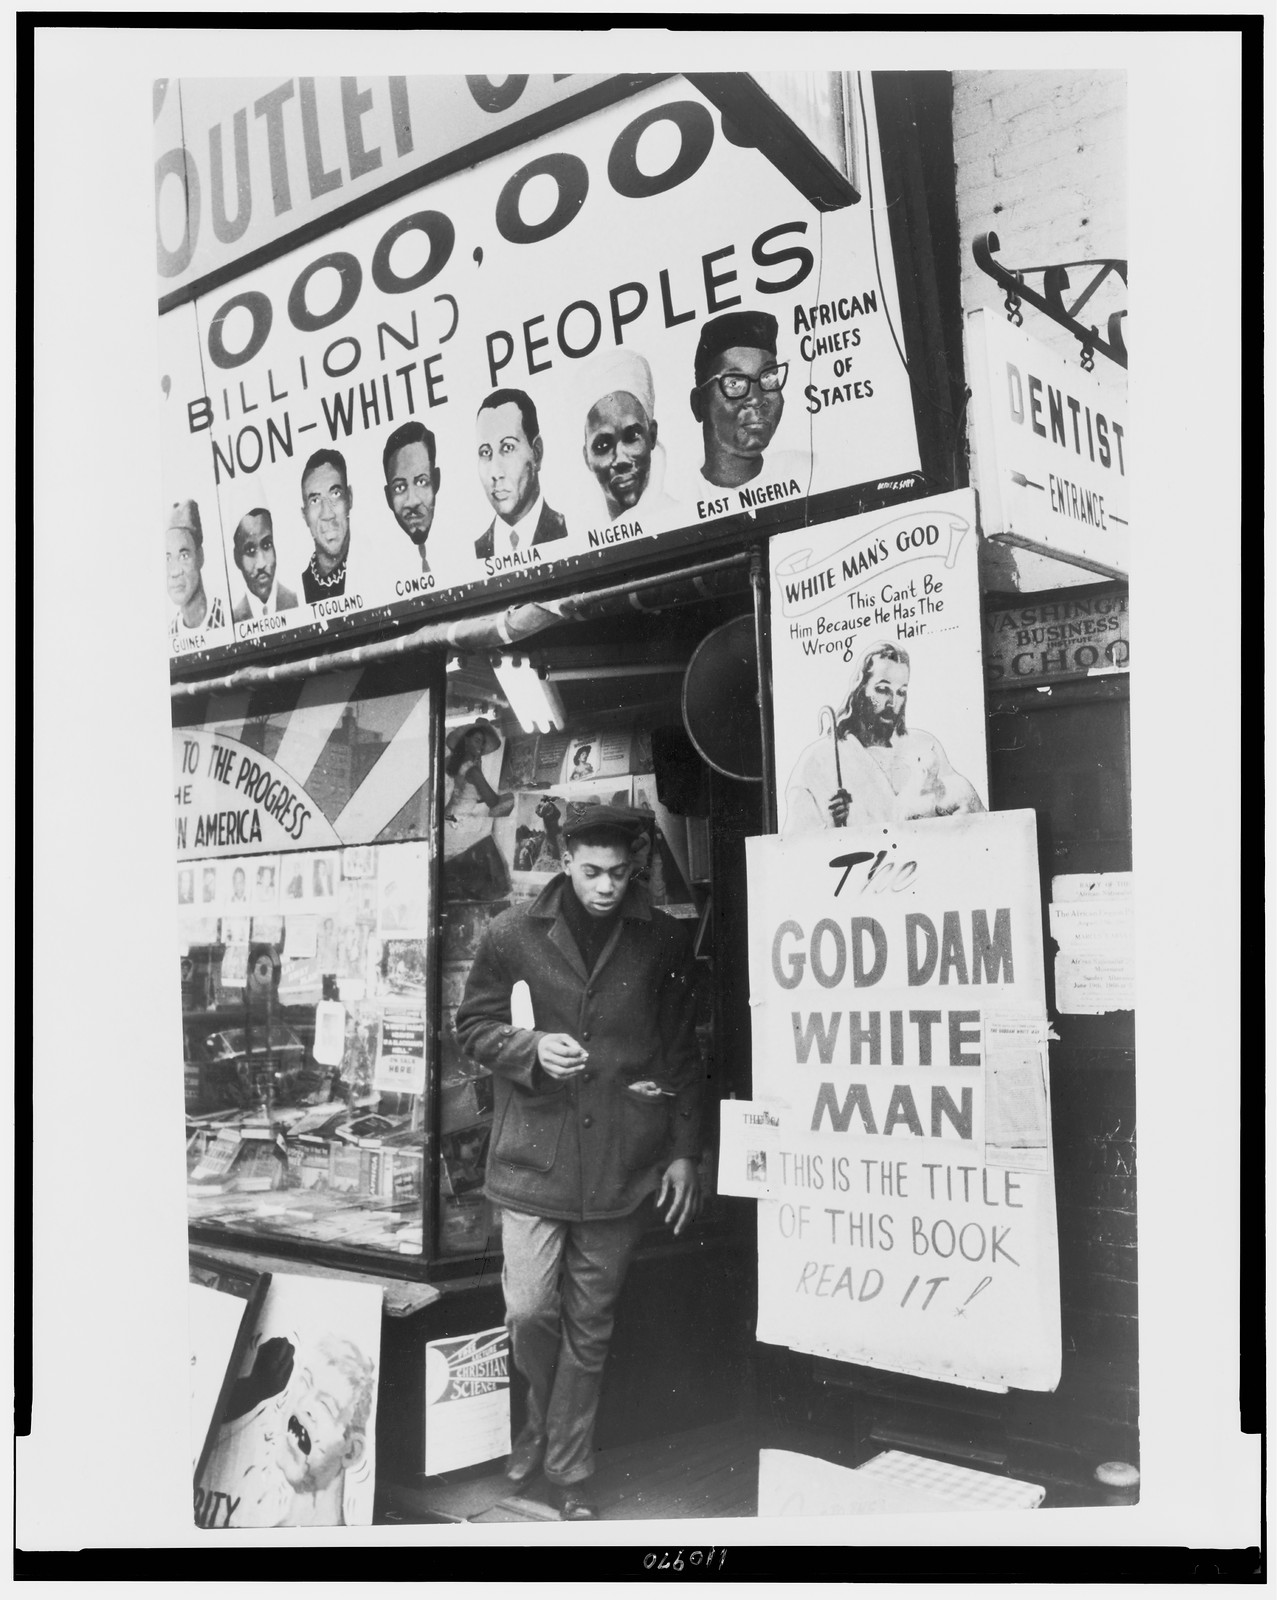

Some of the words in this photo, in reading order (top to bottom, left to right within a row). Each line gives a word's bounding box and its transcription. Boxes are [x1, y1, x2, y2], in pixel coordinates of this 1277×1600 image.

[793, 290, 878, 335] AFRICAN
[212, 353, 449, 486] NON-WHITE
[486, 220, 815, 388] PEOPLES
[799, 327, 862, 363] CHIEFS
[833, 356, 853, 378] OF
[804, 379, 874, 415] STATES
[1005, 361, 1125, 477] DENTIST
[697, 497, 731, 520] EAST
[739, 479, 802, 511] NIGERIA
[1048, 472, 1107, 531] ENTRANCE
[588, 520, 644, 548] NIGERIA
[484, 547, 542, 577] SOMALIA
[785, 566, 837, 605] WHITE
[841, 536, 890, 583] MAN'S
[895, 523, 940, 554] GOD
[395, 574, 436, 597] CONGO
[847, 592, 876, 612] This
[880, 578, 918, 604] Can't
[923, 574, 944, 595] Be
[238, 614, 288, 640] CAMEROON
[310, 594, 364, 620] TOGOLAND
[789, 622, 814, 641] Him
[815, 615, 872, 636] Because
[874, 608, 891, 625] He
[893, 602, 917, 622] Has
[917, 597, 945, 617] The
[172, 634, 207, 654] GUINEA
[802, 633, 859, 663] Wrong
[1015, 616, 1120, 648] BUSINESS
[1047, 636, 1093, 650] INSTITUTE
[182, 740, 200, 775] TO
[207, 744, 238, 786] THE
[234, 755, 312, 841] PROGRESS
[194, 808, 263, 849] AMERICA
[828, 849, 919, 898] The
[770, 915, 889, 991] GOD
[904, 906, 1016, 989] DAM
[790, 1010, 981, 1067] WHITE
[810, 1081, 974, 1141] MAN
[778, 1150, 825, 1190] THIS
[831, 1157, 851, 1194] IS
[860, 1159, 909, 1198] THE
[921, 1163, 1024, 1208] TITLE
[778, 1202, 811, 1240] OF
[824, 1207, 895, 1252] THIS
[911, 1215, 1020, 1267] BOOK
[795, 1260, 885, 1303] READ
[456, 1355, 508, 1379] CHRISTIAN
[450, 1379, 498, 1401] SCIENCE
